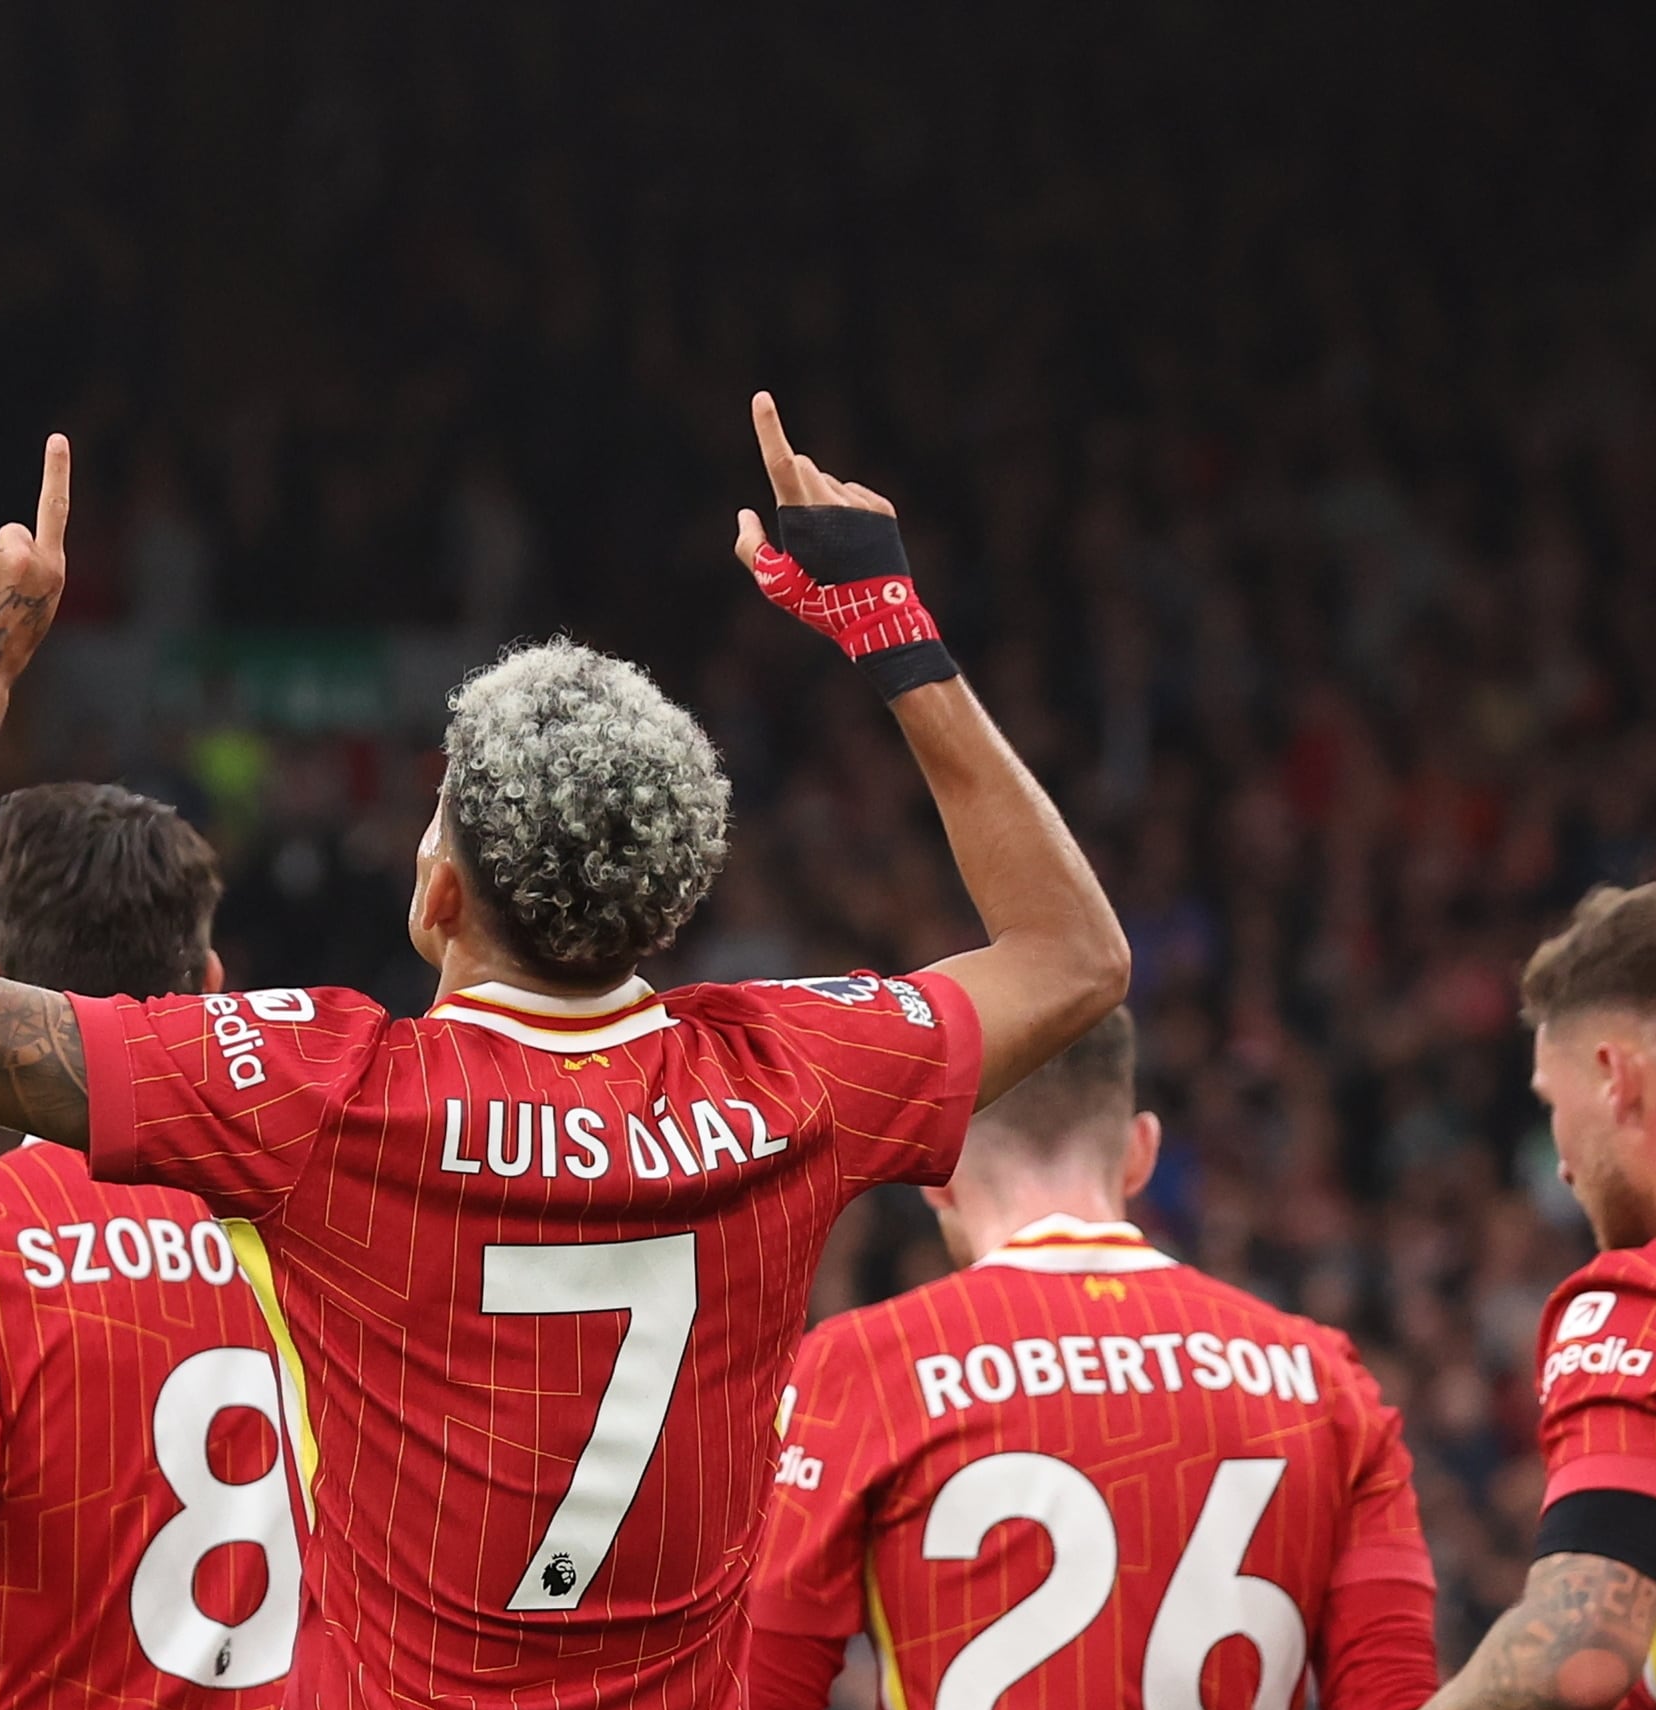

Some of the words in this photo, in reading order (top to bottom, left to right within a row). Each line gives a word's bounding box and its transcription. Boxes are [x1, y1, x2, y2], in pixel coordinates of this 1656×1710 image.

[201, 994, 266, 1091] edia
[441, 1097, 611, 1180] LUIS
[16, 1216, 249, 1289] SZOBO
[915, 1331, 1320, 1419] ROBERTSON
[1540, 1335, 1654, 1402] pedia
[481, 1231, 698, 1611] 7
[130, 1346, 301, 1690] 8
